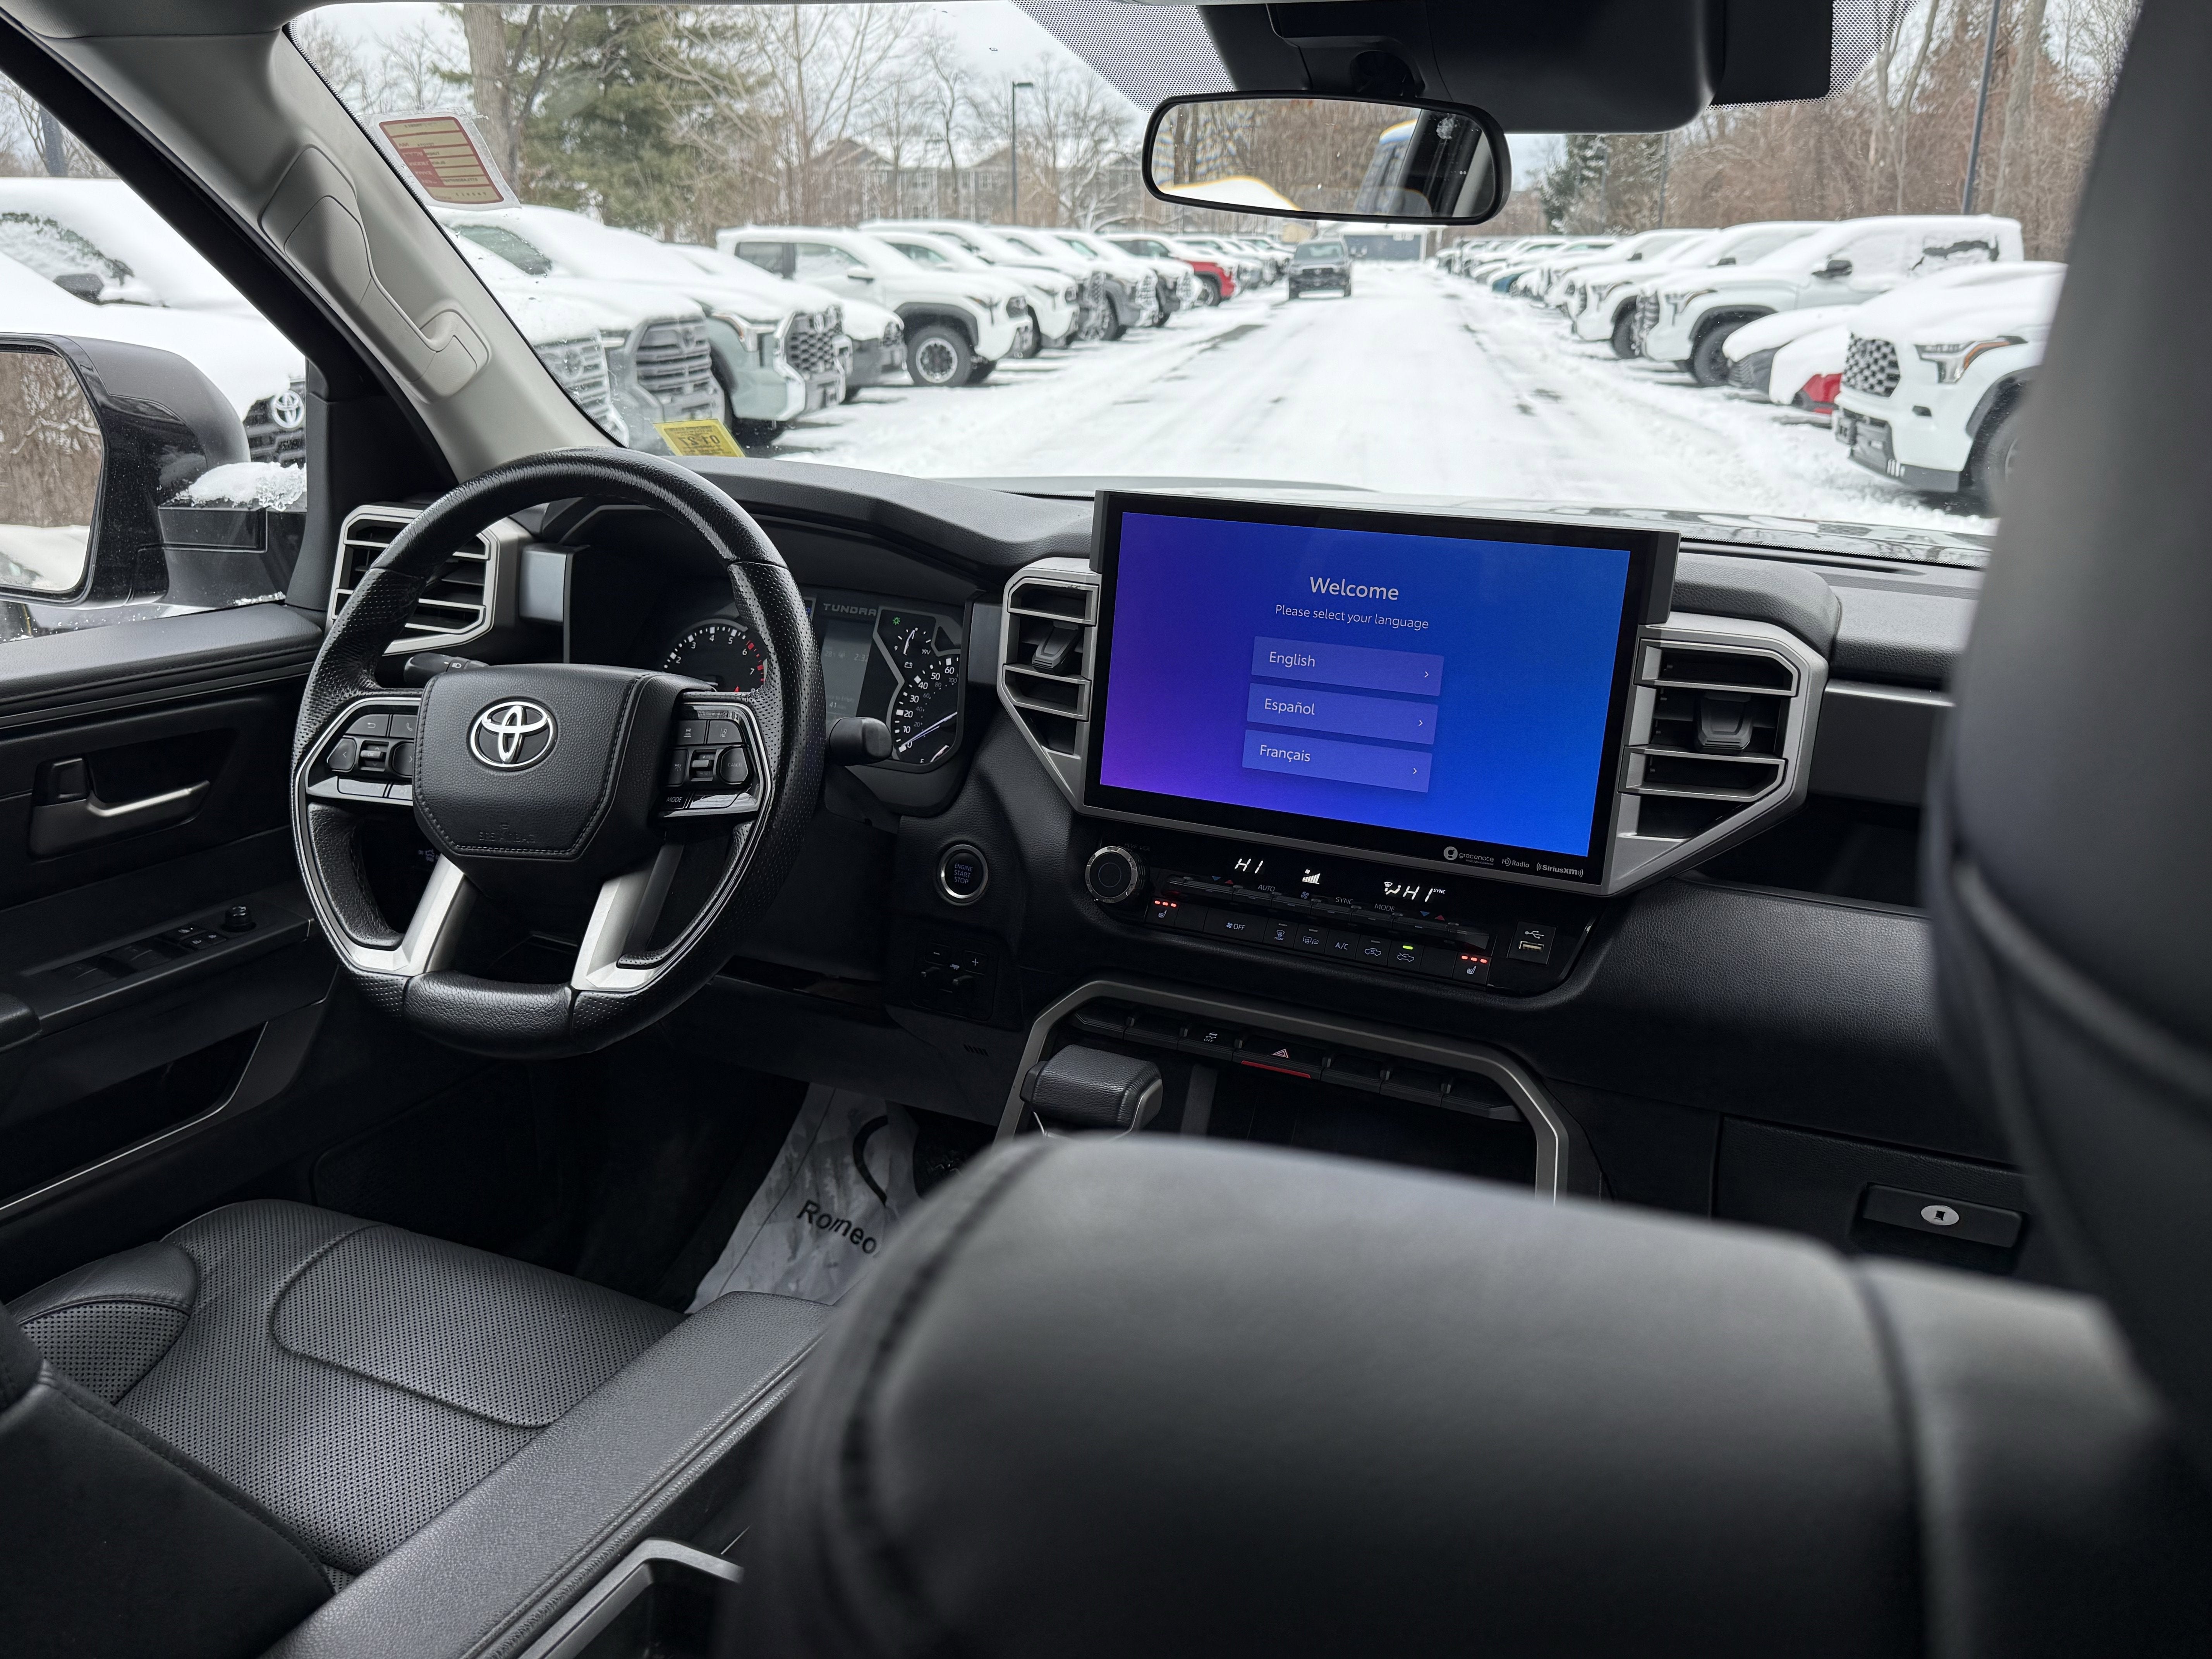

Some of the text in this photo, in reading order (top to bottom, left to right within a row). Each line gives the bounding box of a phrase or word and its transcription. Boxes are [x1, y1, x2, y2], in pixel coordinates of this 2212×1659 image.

[1310, 576, 1400, 601] Welcome
[823, 603, 877, 616] TUNDRA
[1276, 605, 1429, 631] Please select your language
[1269, 651, 1316, 668] English
[931, 672, 941, 680] 50
[909, 695, 919, 703] 30
[1264, 698, 1315, 715] Español
[903, 710, 914, 718] 20
[1259, 744, 1311, 763] Français
[1459, 853, 1494, 862] gracenote
[954, 863, 973, 872] ENGINE
[1234, 858, 1264, 874] HI
[954, 869, 970, 878] START
[1402, 886, 1433, 902] HI
[1374, 903, 1395, 912] MODE
[1335, 942, 1349, 950] A/C
[796, 1199, 878, 1254] Romeo
